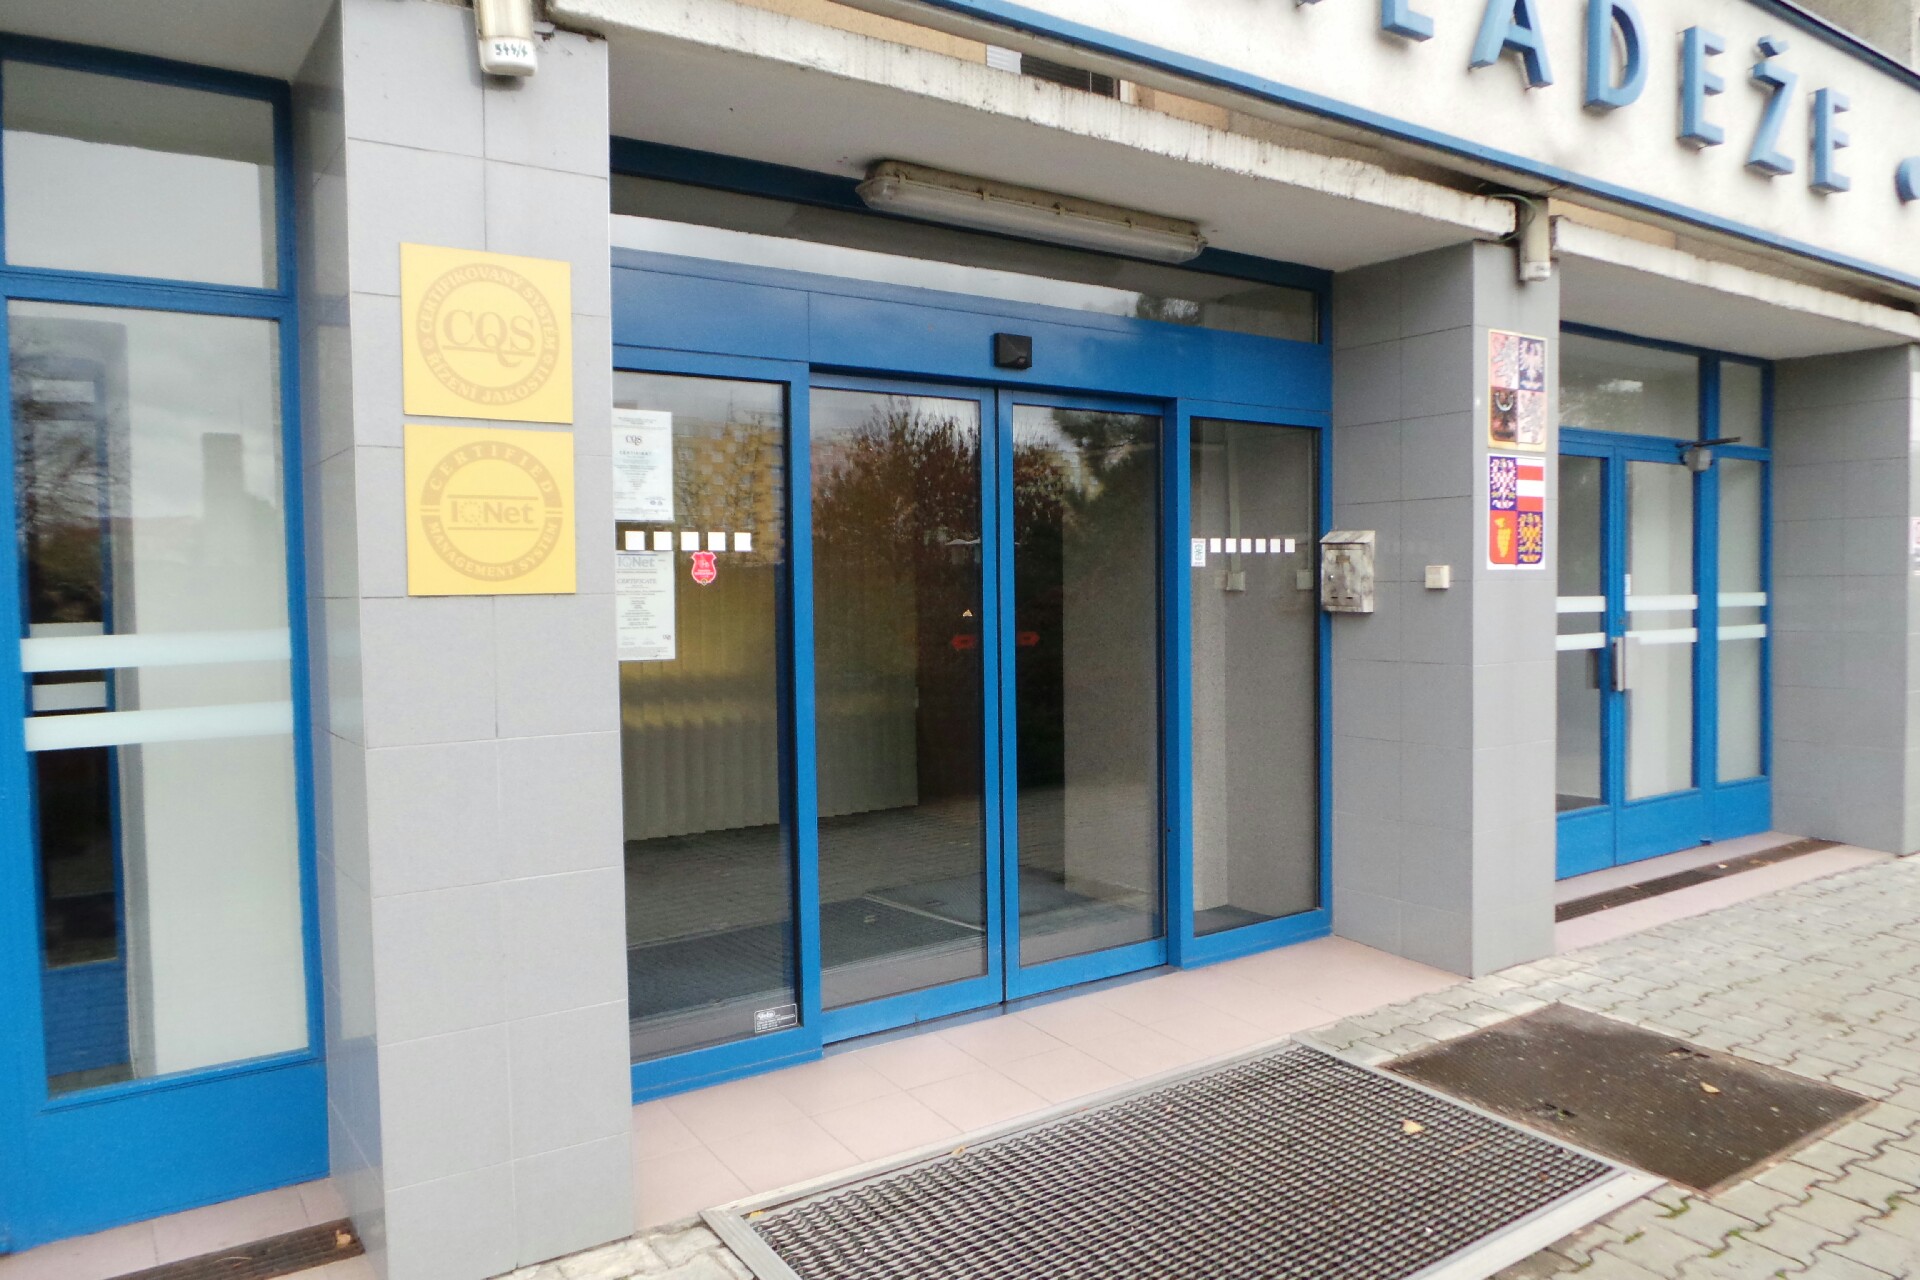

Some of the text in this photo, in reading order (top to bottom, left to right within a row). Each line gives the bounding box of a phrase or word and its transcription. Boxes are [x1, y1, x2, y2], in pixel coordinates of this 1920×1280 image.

[442, 309, 536, 368] CQS
[482, 365, 550, 403] JAKOSTI
[429, 444, 554, 493] CERTIFIED
[428, 522, 558, 577] MANAGEMENT SYSTEM
[618, 556, 655, 569] IQNet
